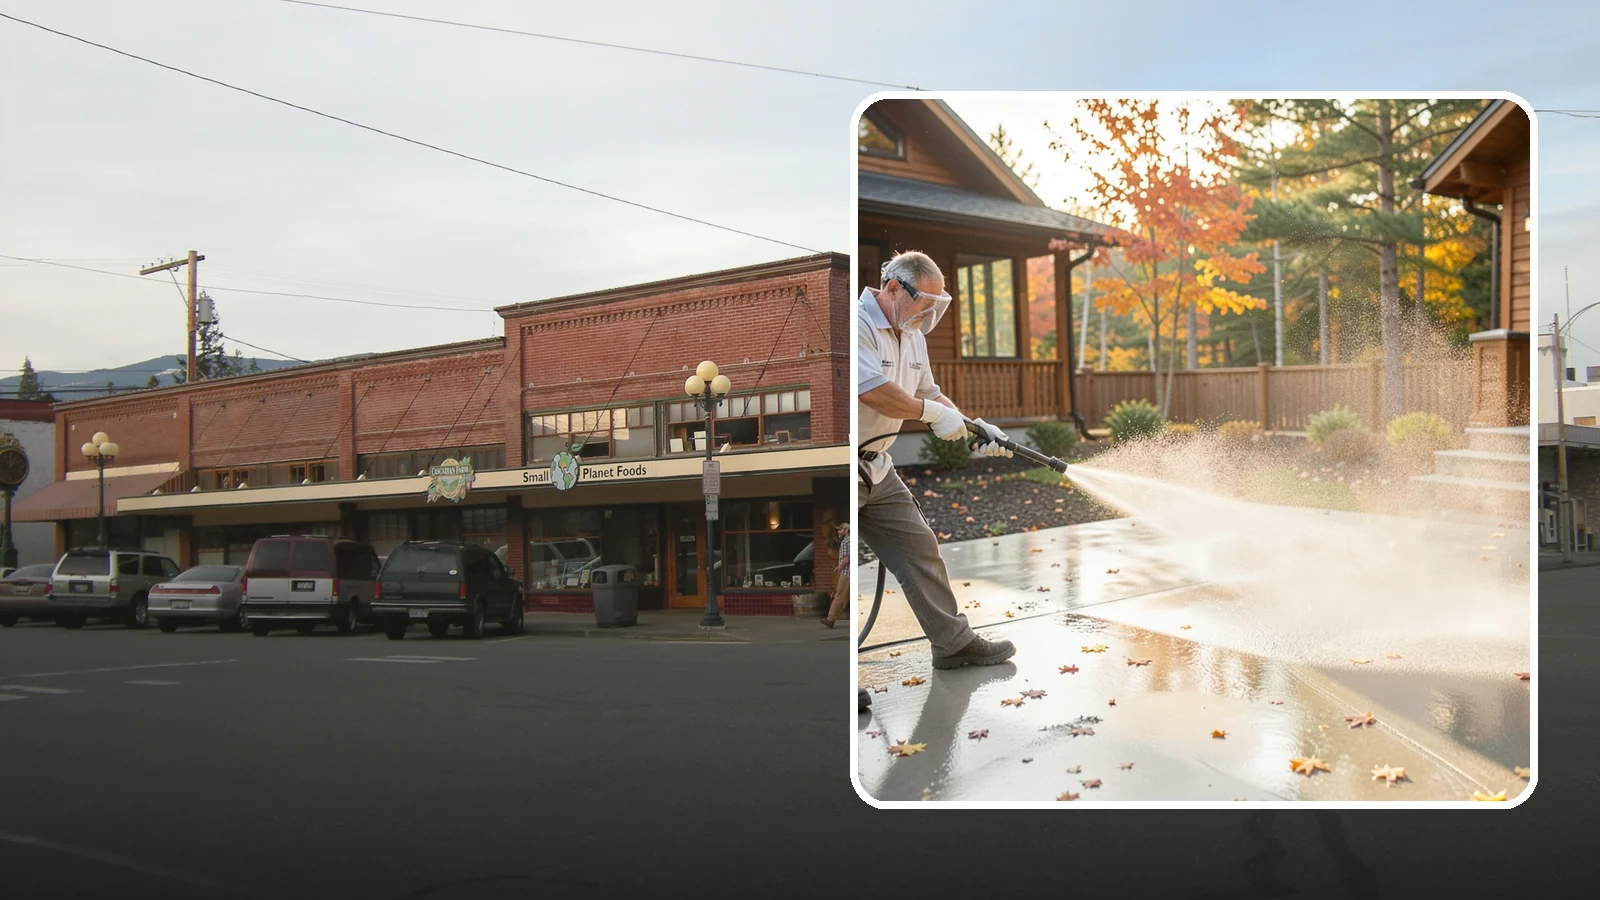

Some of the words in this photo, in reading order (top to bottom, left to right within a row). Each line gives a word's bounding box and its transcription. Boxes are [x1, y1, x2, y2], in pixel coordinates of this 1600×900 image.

[431, 467, 456, 475] CASCADIAN
[456, 466, 469, 474] FARM
[523, 471, 549, 483] Small
[583, 467, 614, 479] Planet
[617, 464, 647, 477] Foods
